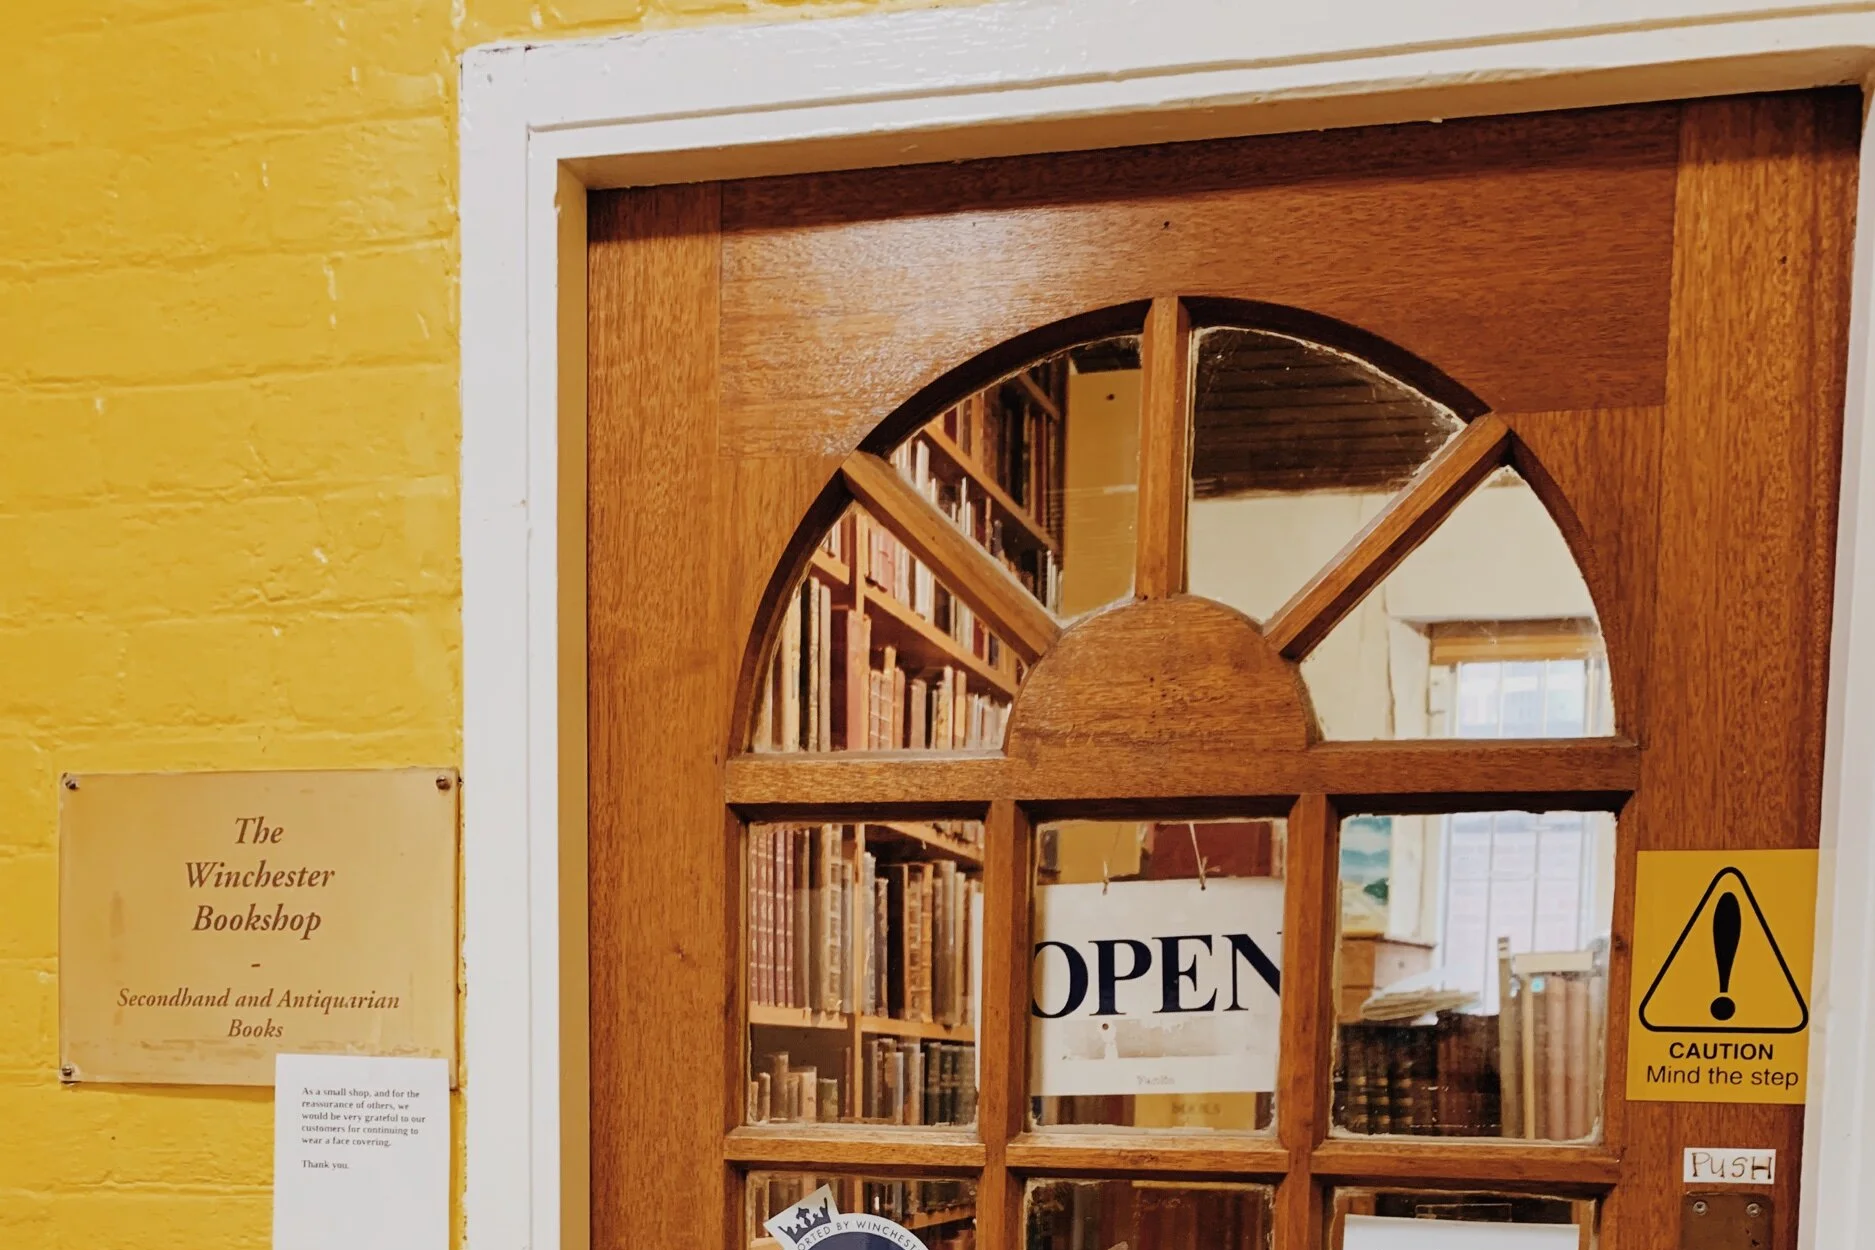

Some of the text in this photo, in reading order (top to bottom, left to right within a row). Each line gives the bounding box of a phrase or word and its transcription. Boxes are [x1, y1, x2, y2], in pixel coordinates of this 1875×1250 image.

[235, 816, 284, 844] The
[186, 860, 335, 888] Winchester
[192, 903, 322, 940] Bookshop
[1031, 933, 1282, 1019] OPEN
[117, 988, 400, 1015] Secondhand and Antiquarian
[228, 1018, 283, 1038] Books
[1669, 1042, 1774, 1060] CAUTION
[1647, 1066, 1799, 1090] Mind the step
[324, 1088, 346, 1096] small
[392, 1090, 404, 1098] for
[407, 1090, 419, 1098] the
[302, 1101, 353, 1109] reassurance
[356, 1101, 364, 1109] of
[367, 1102, 395, 1110] others,
[331, 1113, 341, 1121] be
[365, 1114, 398, 1123] grateful
[302, 1125, 345, 1133] customers
[348, 1125, 360, 1133] for
[363, 1126, 408, 1136] continuing
[333, 1136, 350, 1145] face
[352, 1139, 391, 1148] covering.
[302, 1160, 349, 1171] Thank you.
[1691, 1152, 1773, 1180] PUSH
[837, 1221, 849, 1231] BY
